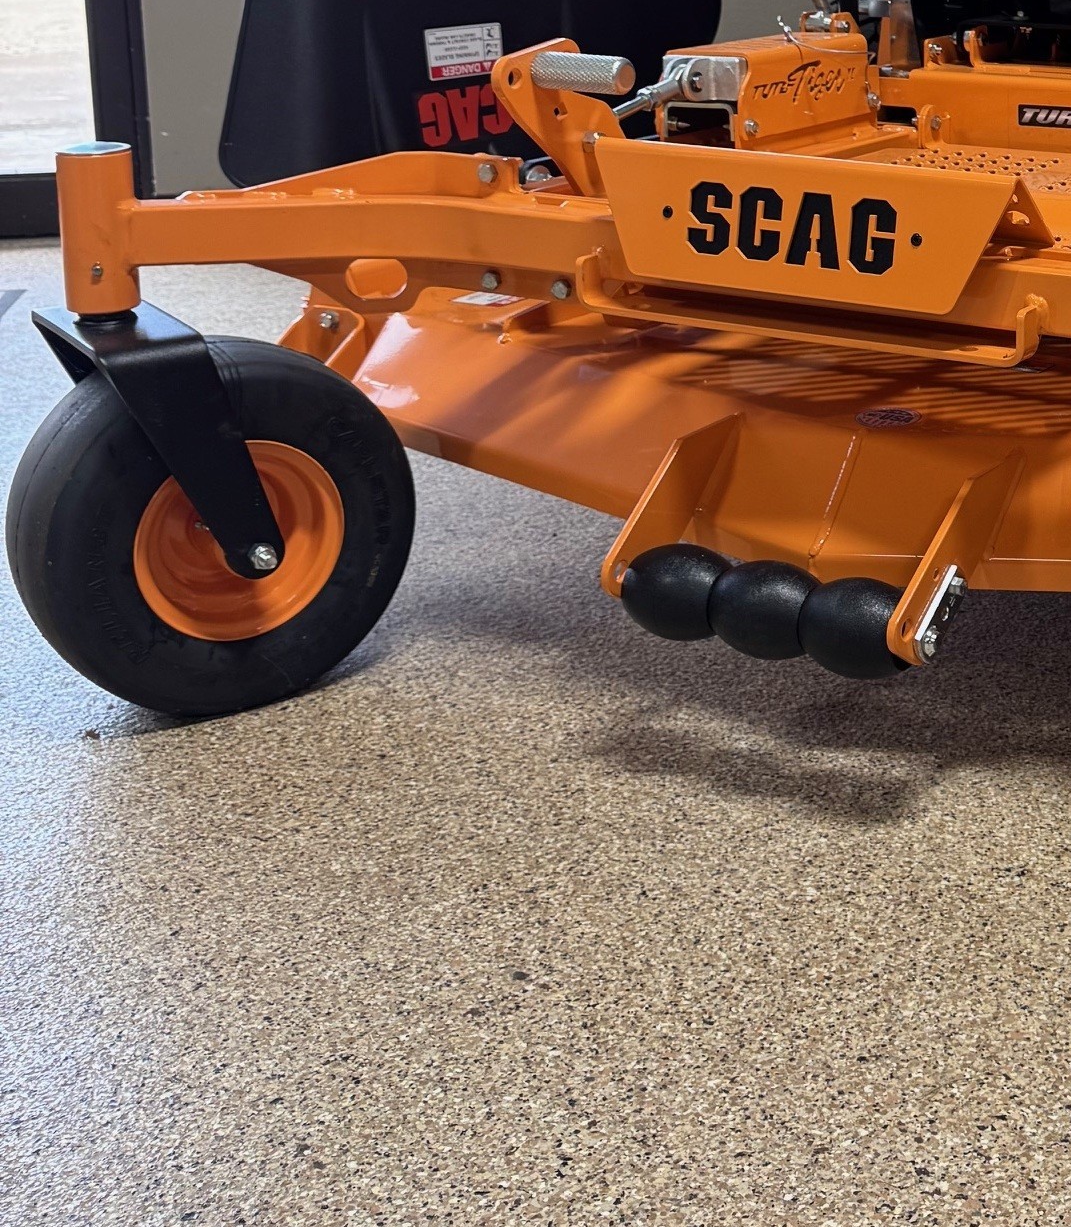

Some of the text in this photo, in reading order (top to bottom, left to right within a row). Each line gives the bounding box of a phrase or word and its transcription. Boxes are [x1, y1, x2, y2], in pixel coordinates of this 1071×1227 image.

[442, 62, 481, 77] DANGER
[418, 84, 513, 148] CAG
[685, 180, 898, 276] SCAG
